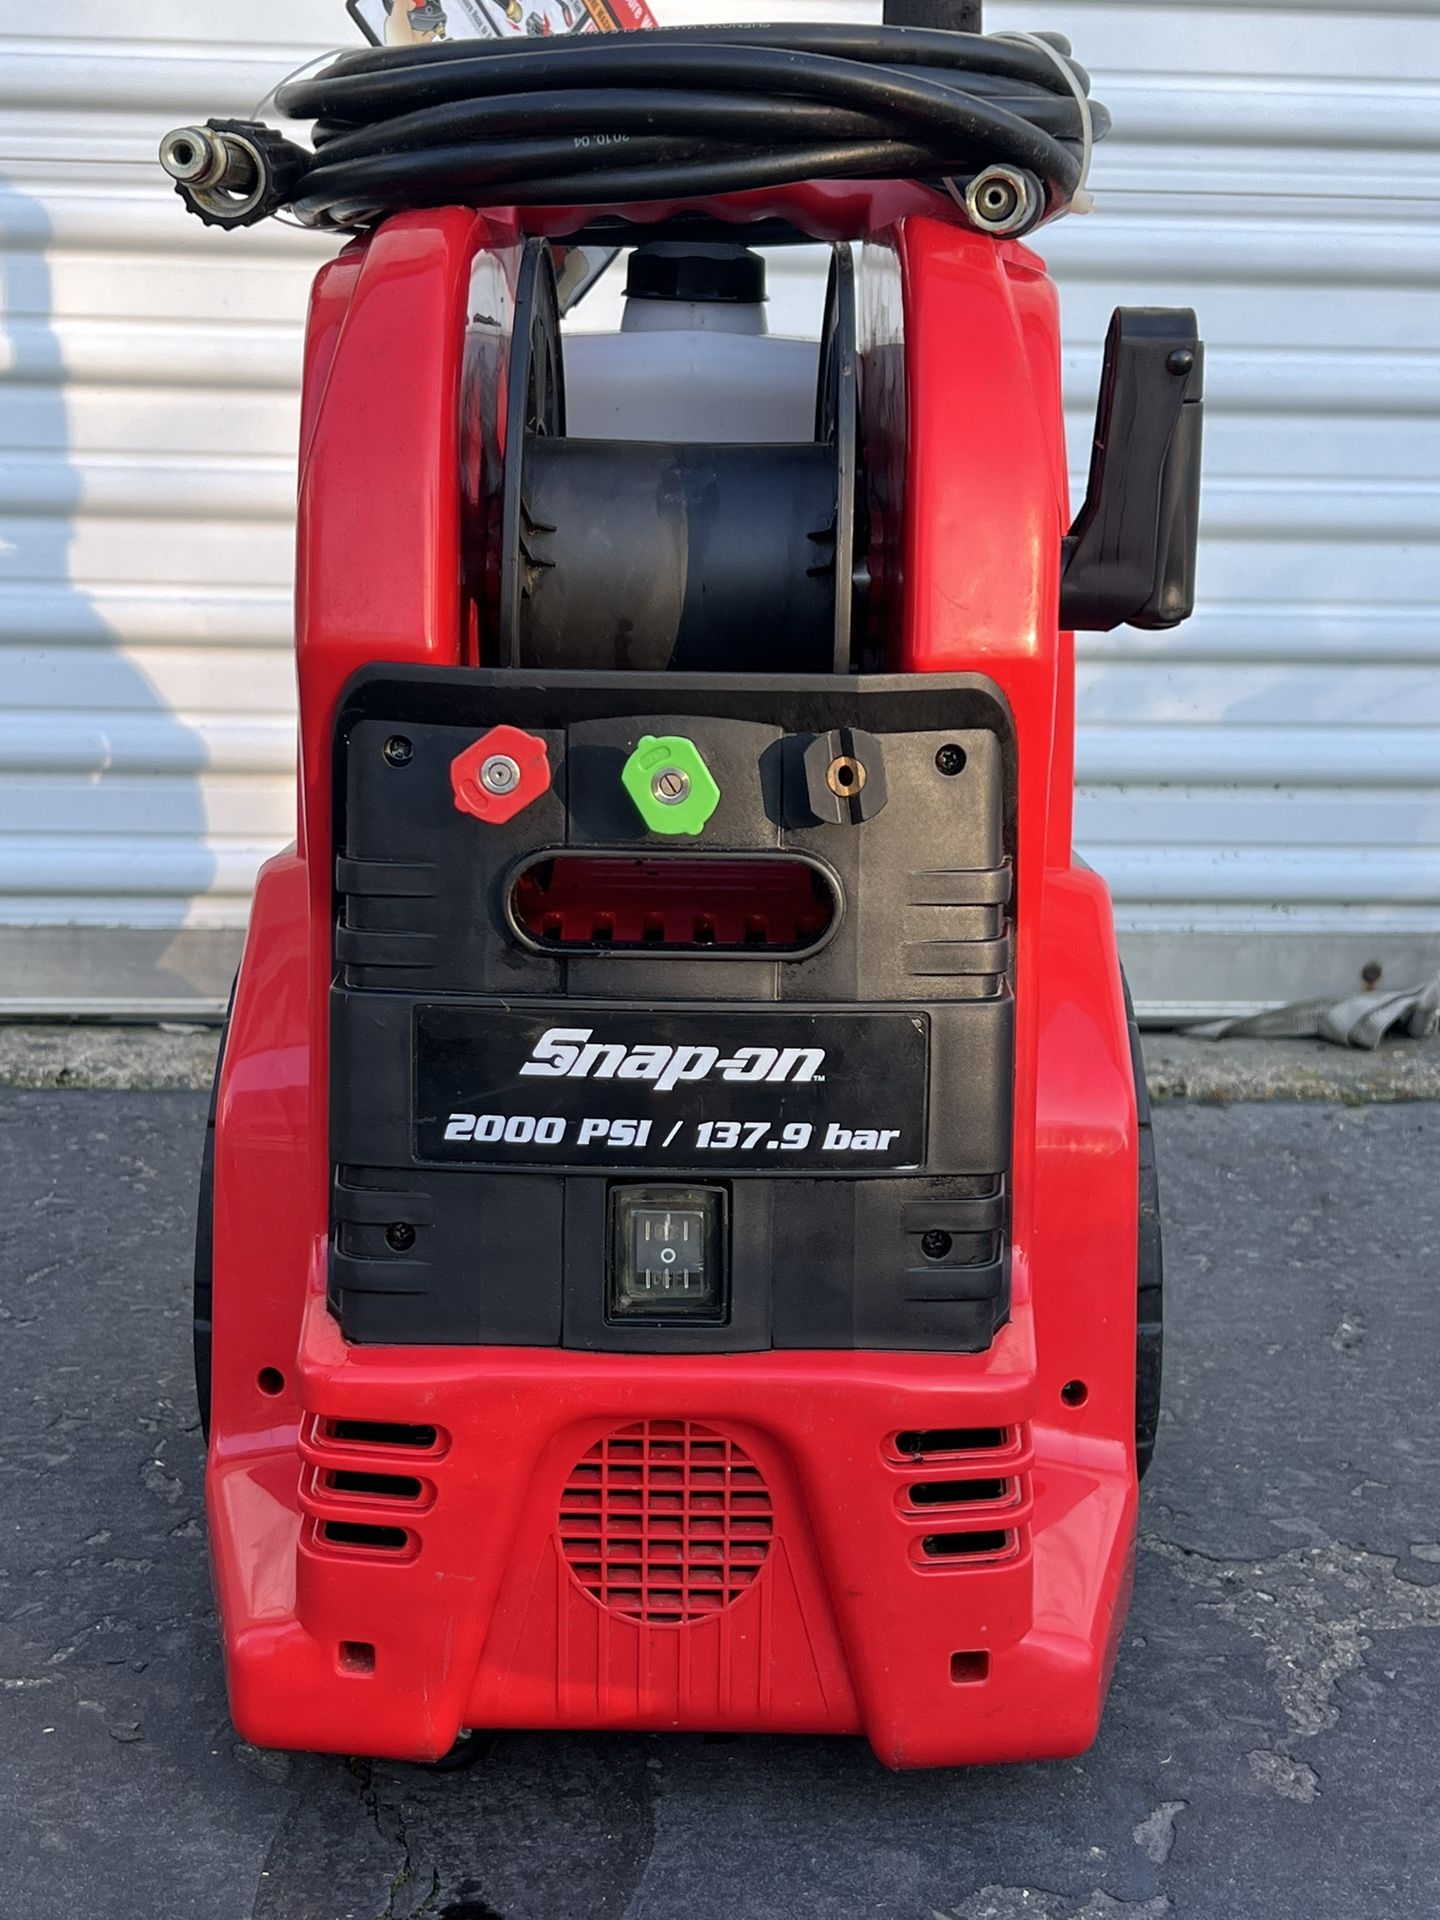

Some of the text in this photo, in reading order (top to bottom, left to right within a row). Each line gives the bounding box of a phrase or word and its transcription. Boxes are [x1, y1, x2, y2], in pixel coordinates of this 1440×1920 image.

[519, 1028, 825, 1090] Snap-on
[444, 1114, 900, 1150] 2000 PSI / 137.9 bar
